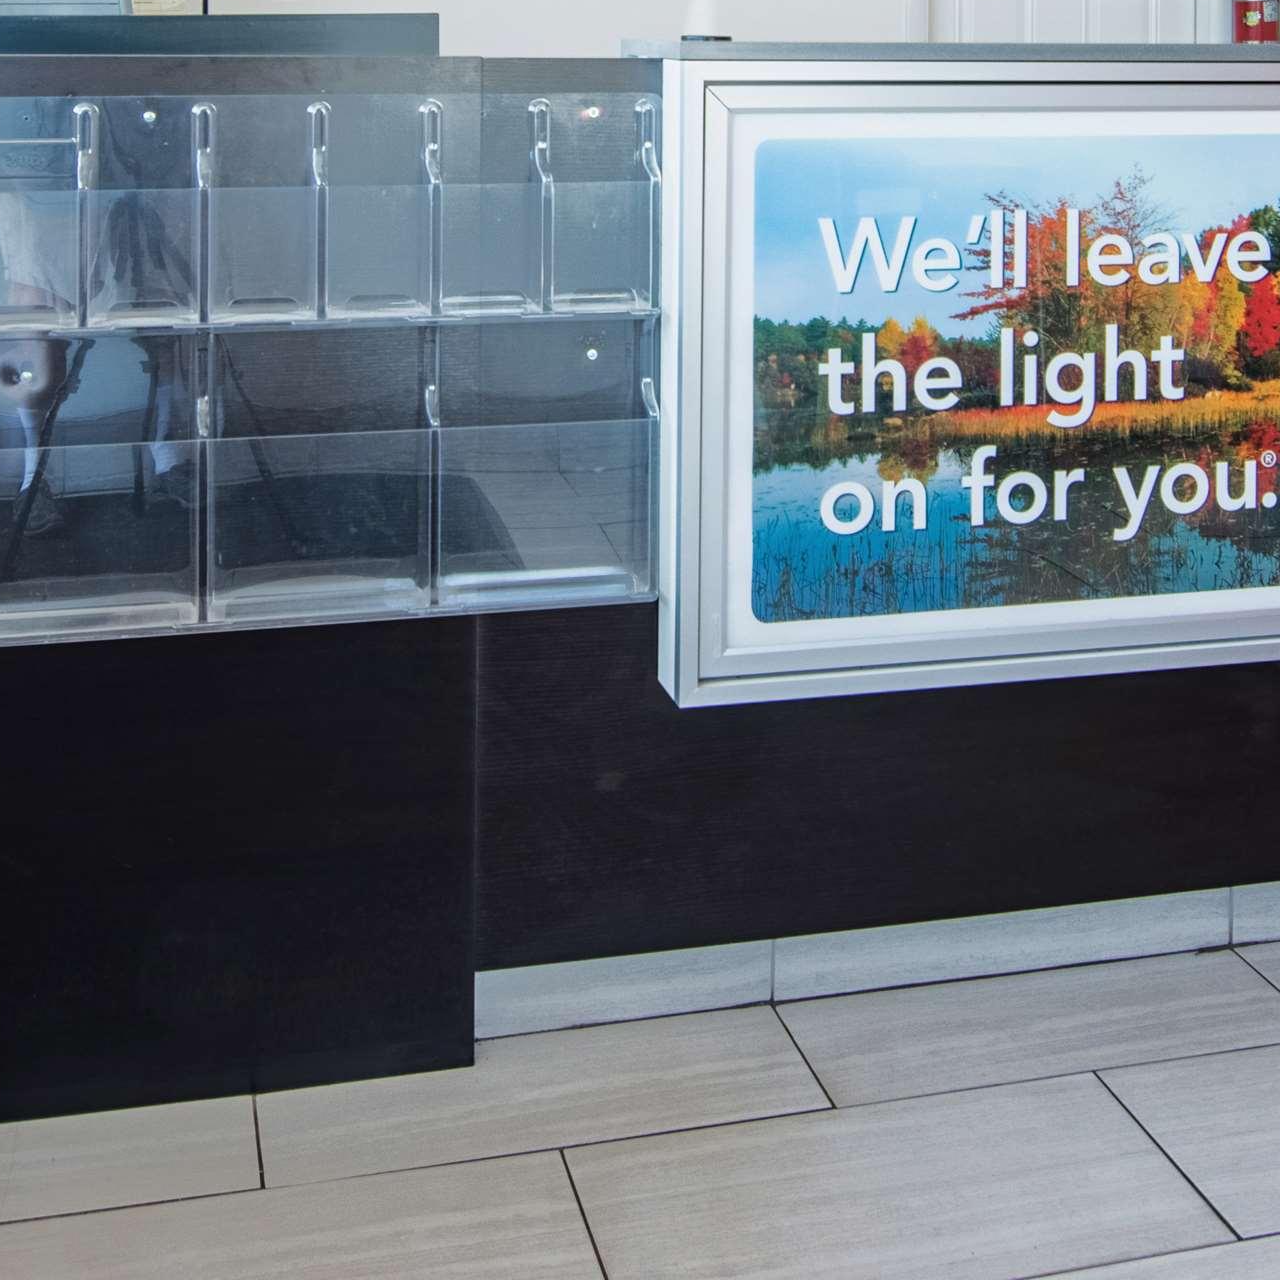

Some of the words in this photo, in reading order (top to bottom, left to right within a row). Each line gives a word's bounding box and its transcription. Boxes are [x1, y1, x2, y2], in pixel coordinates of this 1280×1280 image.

[818, 209, 1028, 294] We'll
[1066, 208, 1272, 288] leave
[819, 332, 964, 416] the
[999, 324, 1186, 429] light
[819, 477, 927, 535] on
[962, 445, 1084, 528] for
